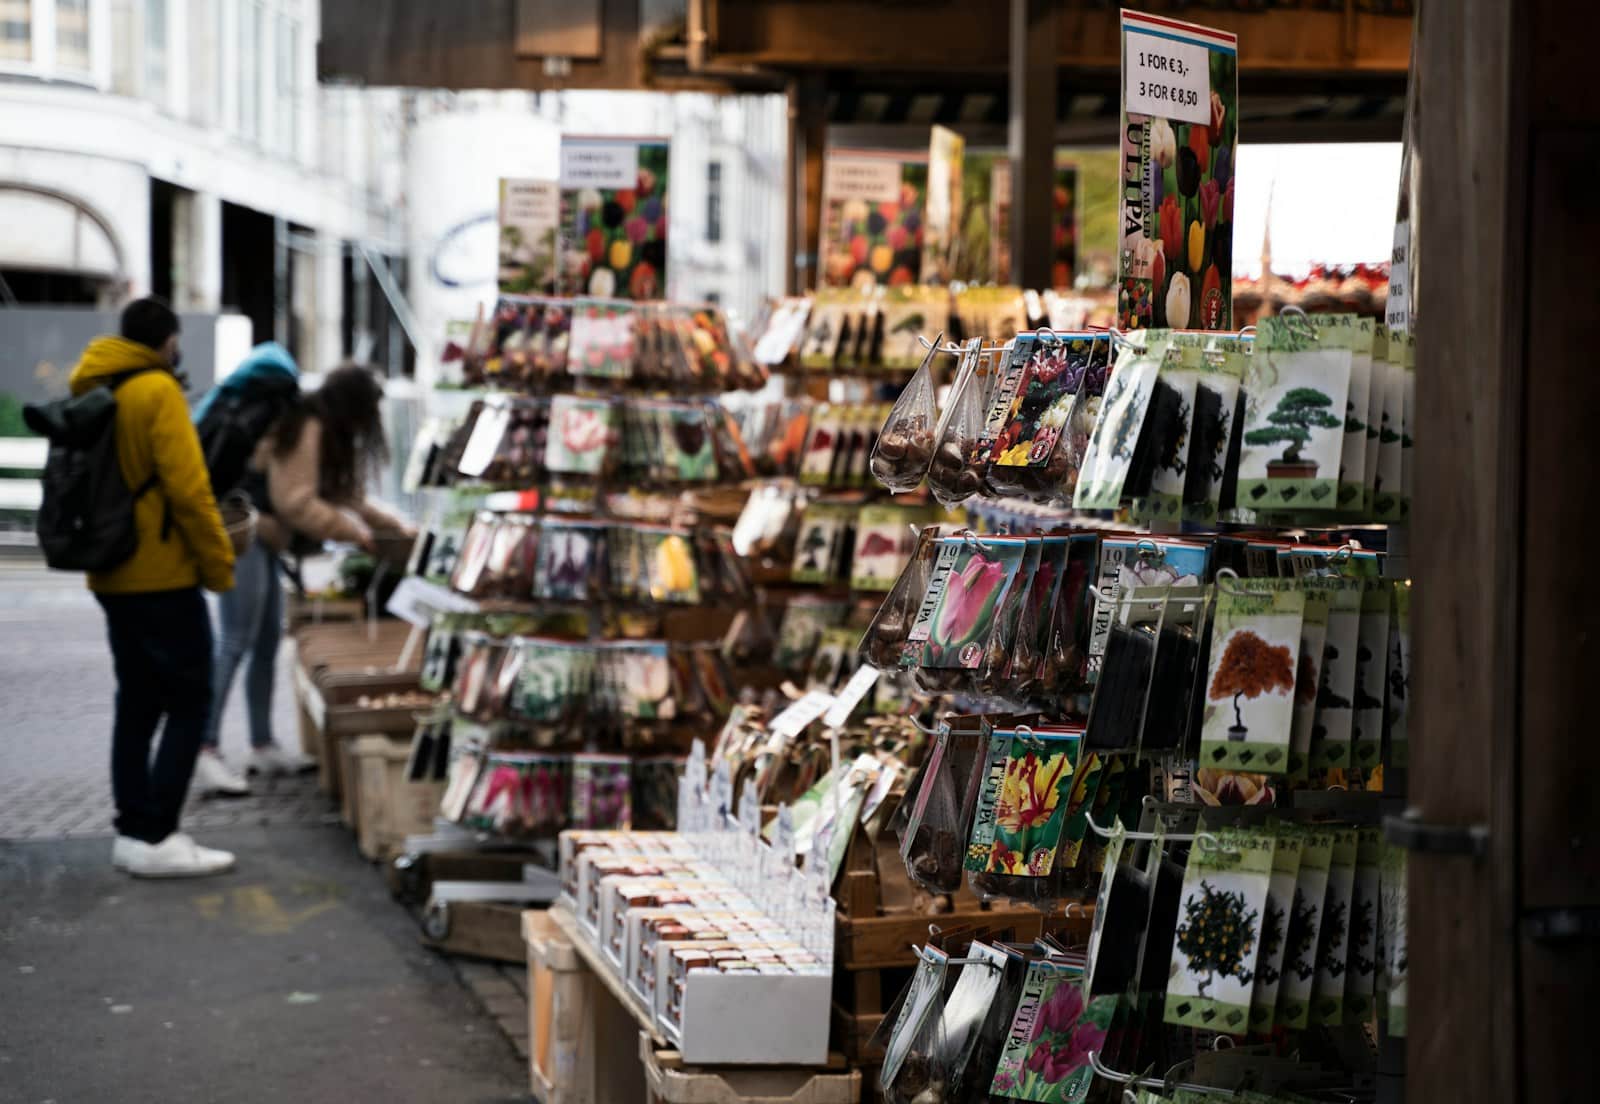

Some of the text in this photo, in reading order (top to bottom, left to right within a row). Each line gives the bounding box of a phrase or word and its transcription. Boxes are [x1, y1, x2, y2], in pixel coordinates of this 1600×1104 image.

[1139, 52, 1189, 76] 1 FOR € 3,-
[1139, 82, 1198, 107] 3 FOR € 8,50
[1125, 123, 1143, 238] ULIPA
[1143, 191, 1152, 239] MIXED
[1019, 341, 1028, 354] 7
[990, 361, 1025, 424] TULIPA
[943, 545, 958, 557] 10
[1105, 550, 1122, 562] 10
[918, 563, 952, 623] TULIPA
[999, 739, 1006, 751] 7
[979, 759, 1007, 825] TULIPA
[1008, 990, 1041, 1051] TULIPA
